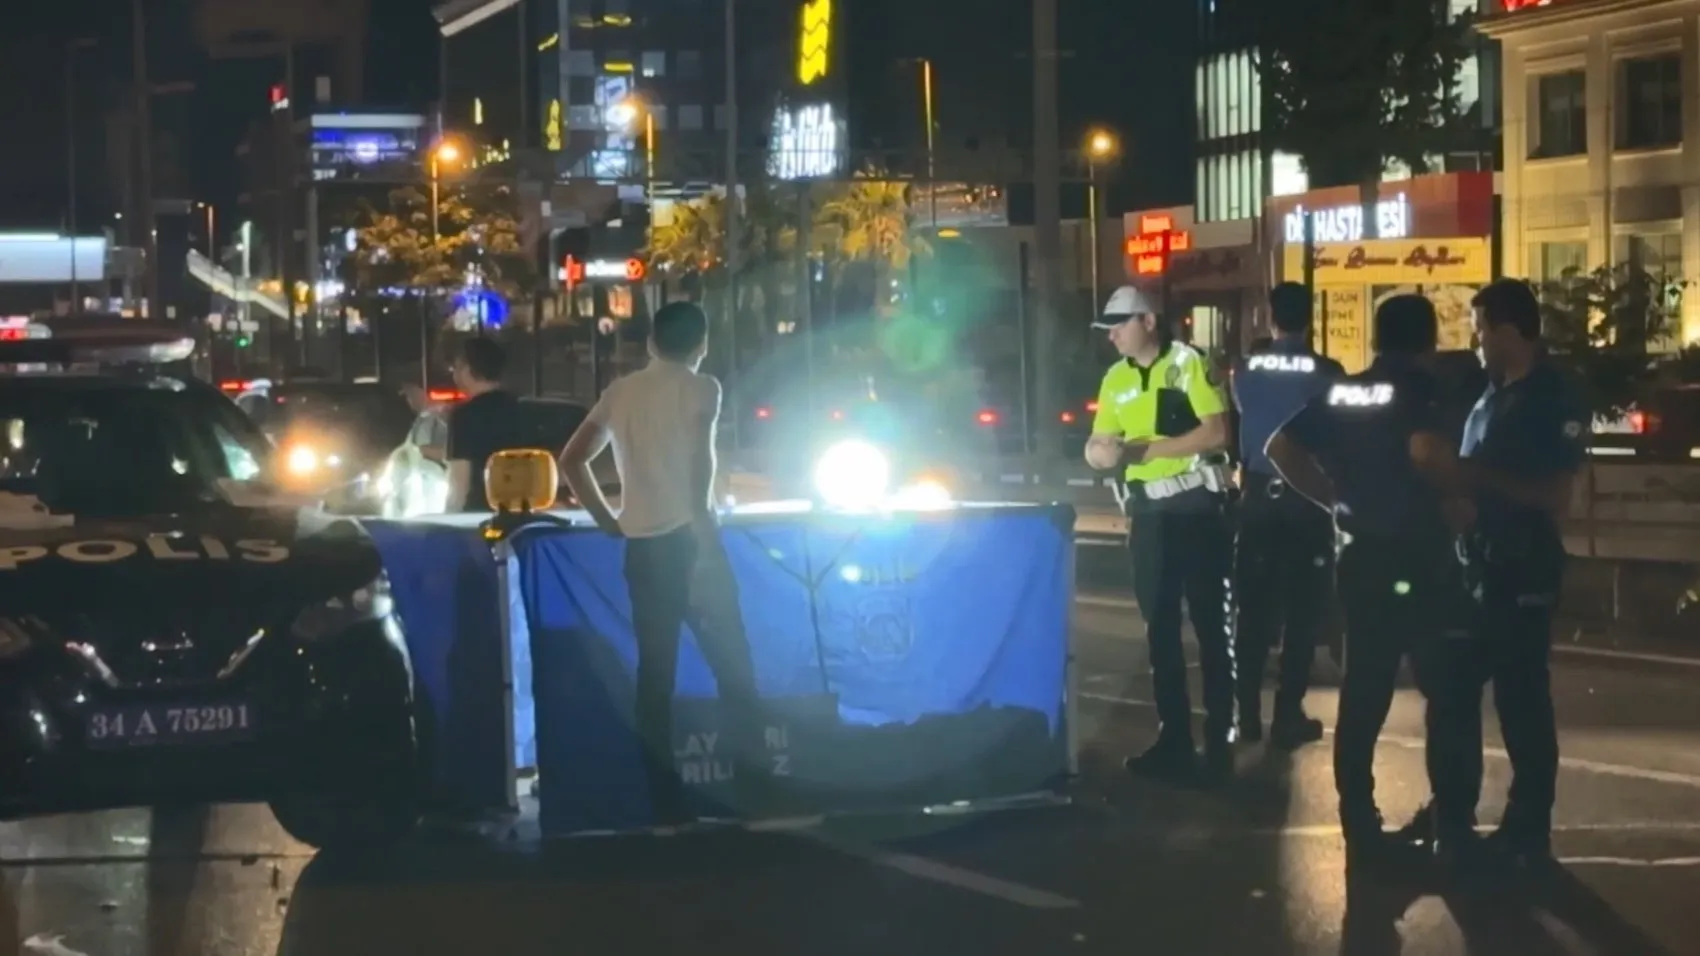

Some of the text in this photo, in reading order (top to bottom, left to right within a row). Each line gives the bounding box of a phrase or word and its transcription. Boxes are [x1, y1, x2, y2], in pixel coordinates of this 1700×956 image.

[91, 705, 249, 738] 34 A 75291
